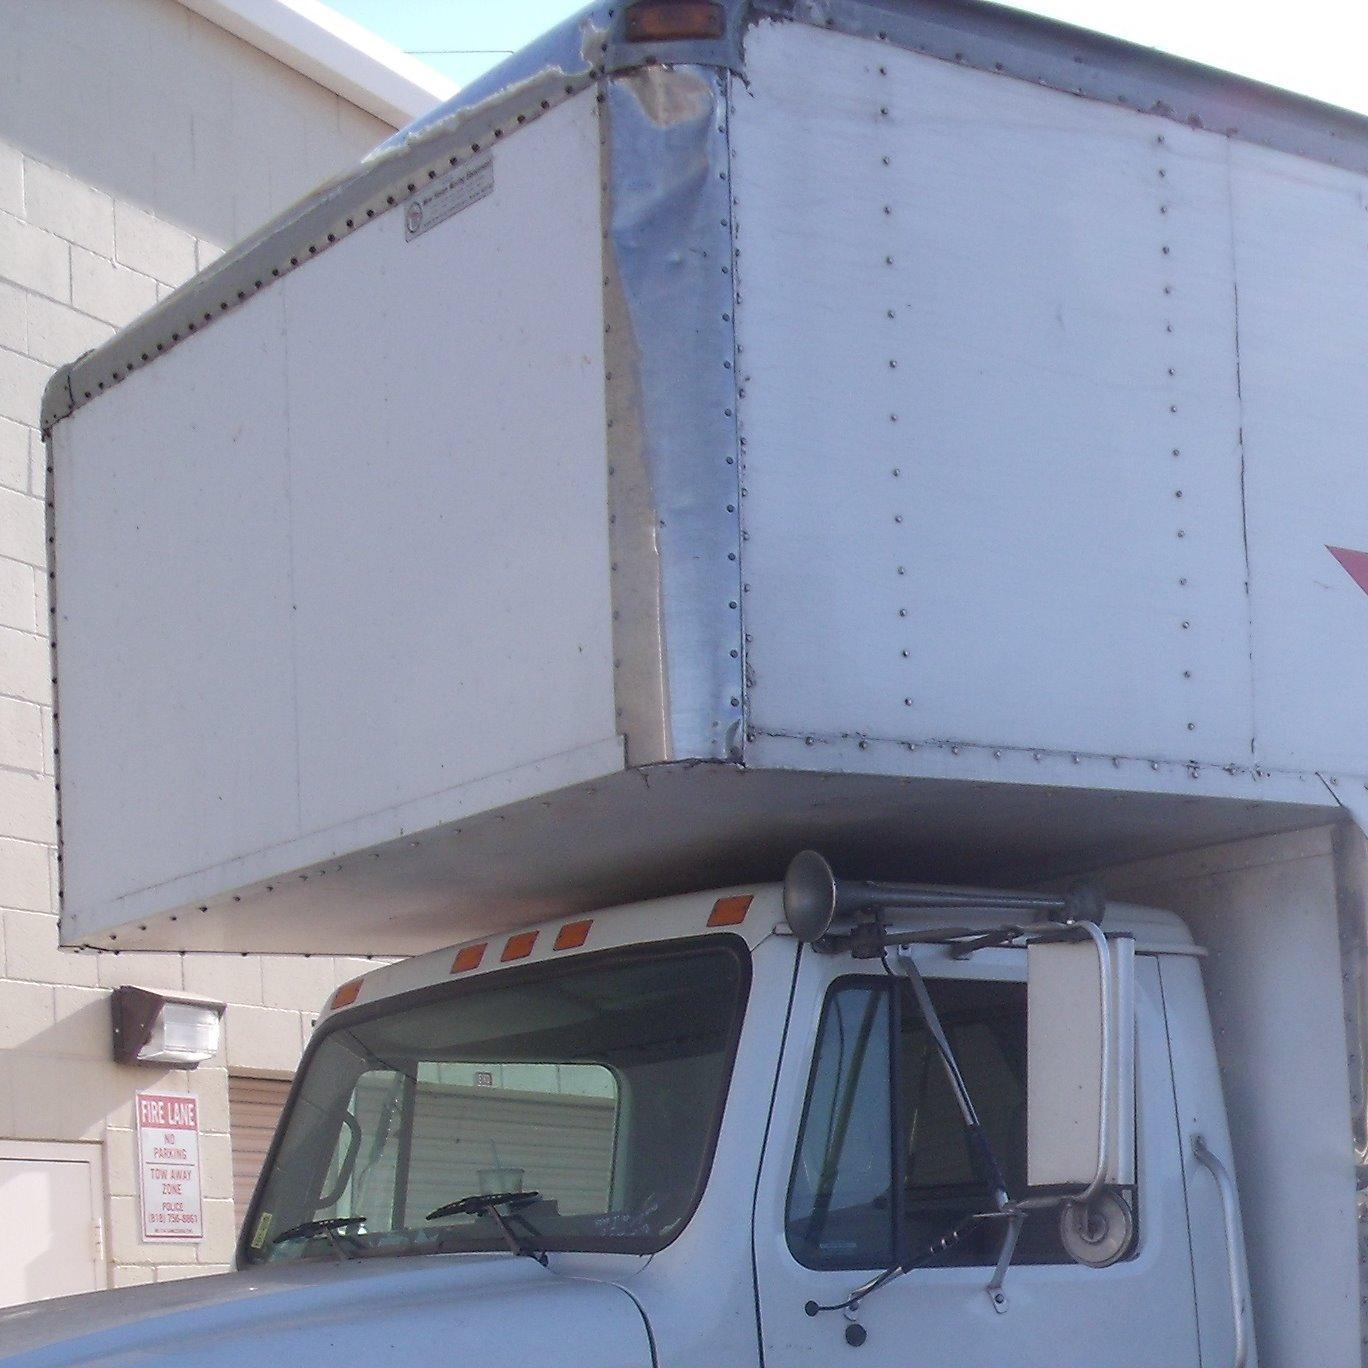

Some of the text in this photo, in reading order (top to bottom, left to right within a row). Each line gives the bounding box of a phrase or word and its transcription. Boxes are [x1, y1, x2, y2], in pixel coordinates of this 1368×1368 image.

[141, 1100, 196, 1126] FIRE LANE
[164, 1133, 175, 1145] NO
[153, 1147, 187, 1160] PARKING
[150, 1168, 192, 1181] TOW AWAY
[162, 1183, 183, 1195] ZONE
